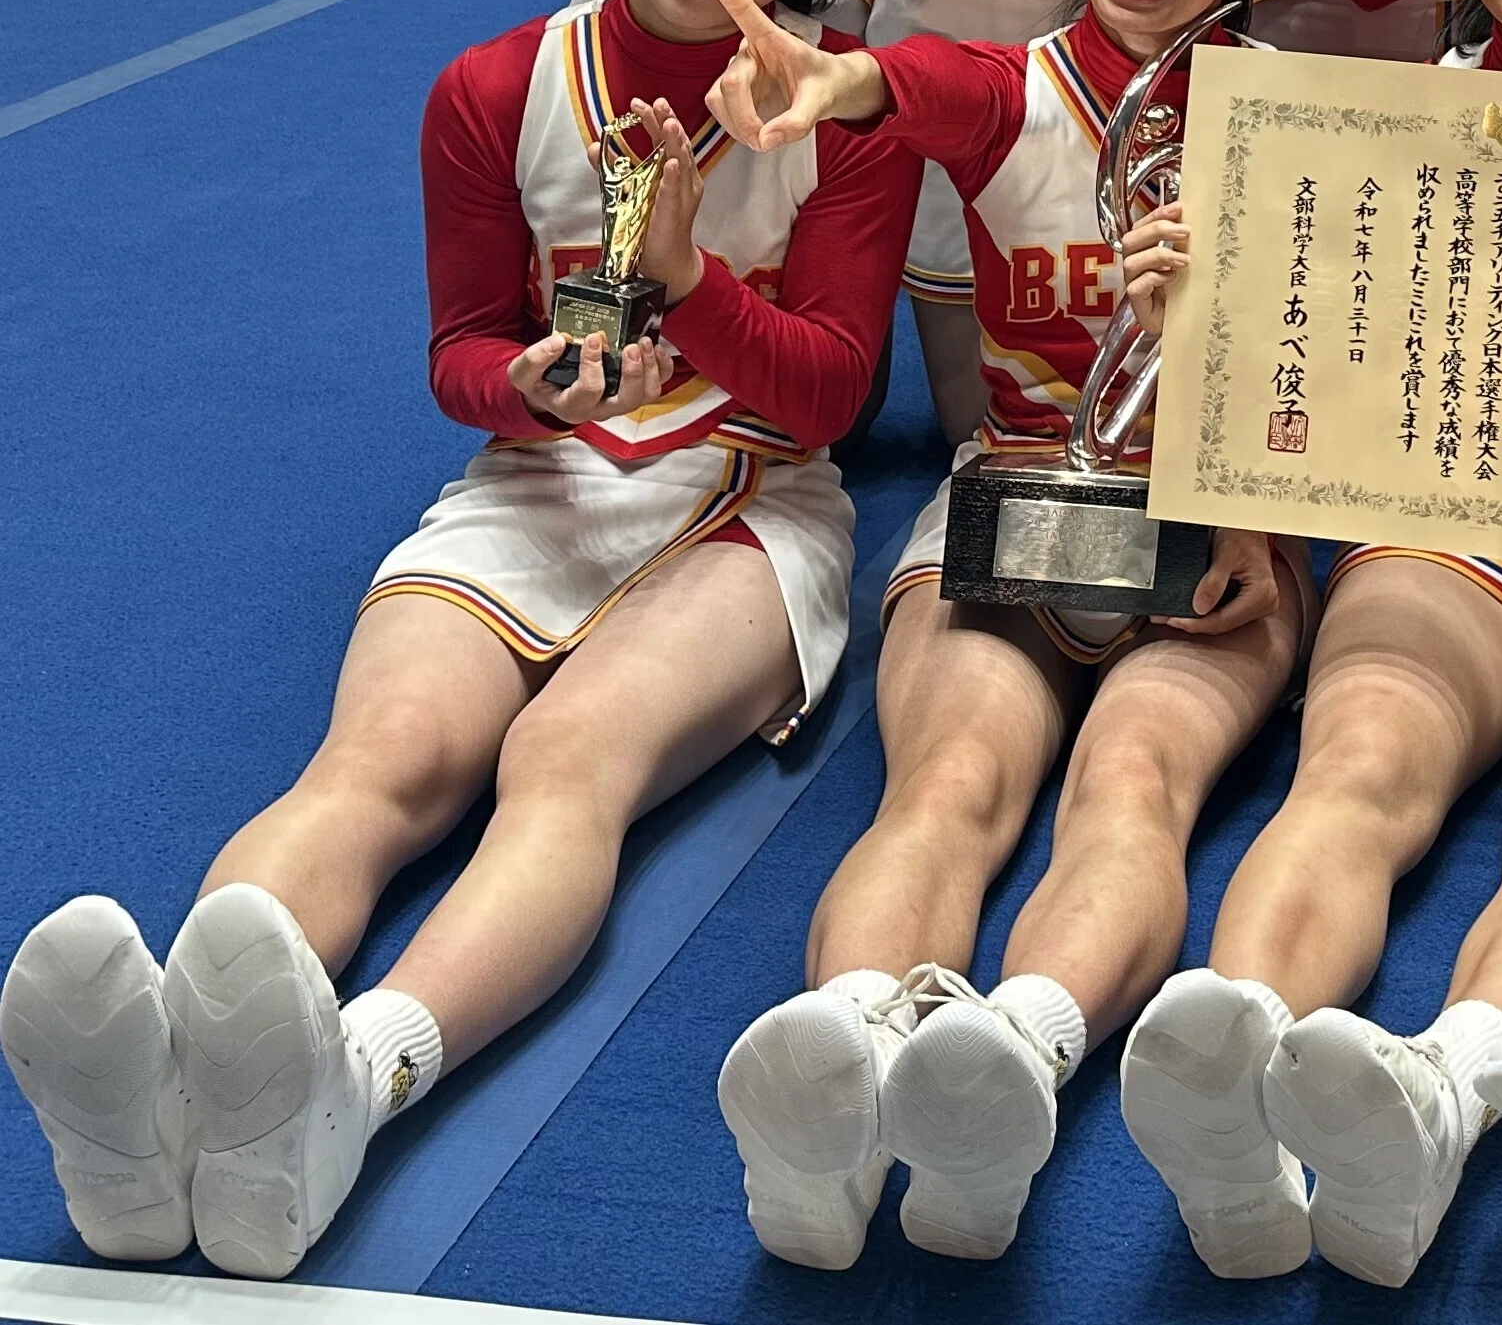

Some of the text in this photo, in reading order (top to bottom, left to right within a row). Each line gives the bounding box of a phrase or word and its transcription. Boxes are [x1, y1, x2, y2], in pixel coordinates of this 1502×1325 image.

[1289, 176, 1318, 288] 文部科学大臣
[1347, 176, 1384, 365] 令和七年八月三十一日
[1396, 162, 1443, 453] 収められましたここにこれを賞します
[1434, 167, 1480, 478] 高等学校部門において優秀な成績を
[1269, 293, 1310, 427] あべ俊子
